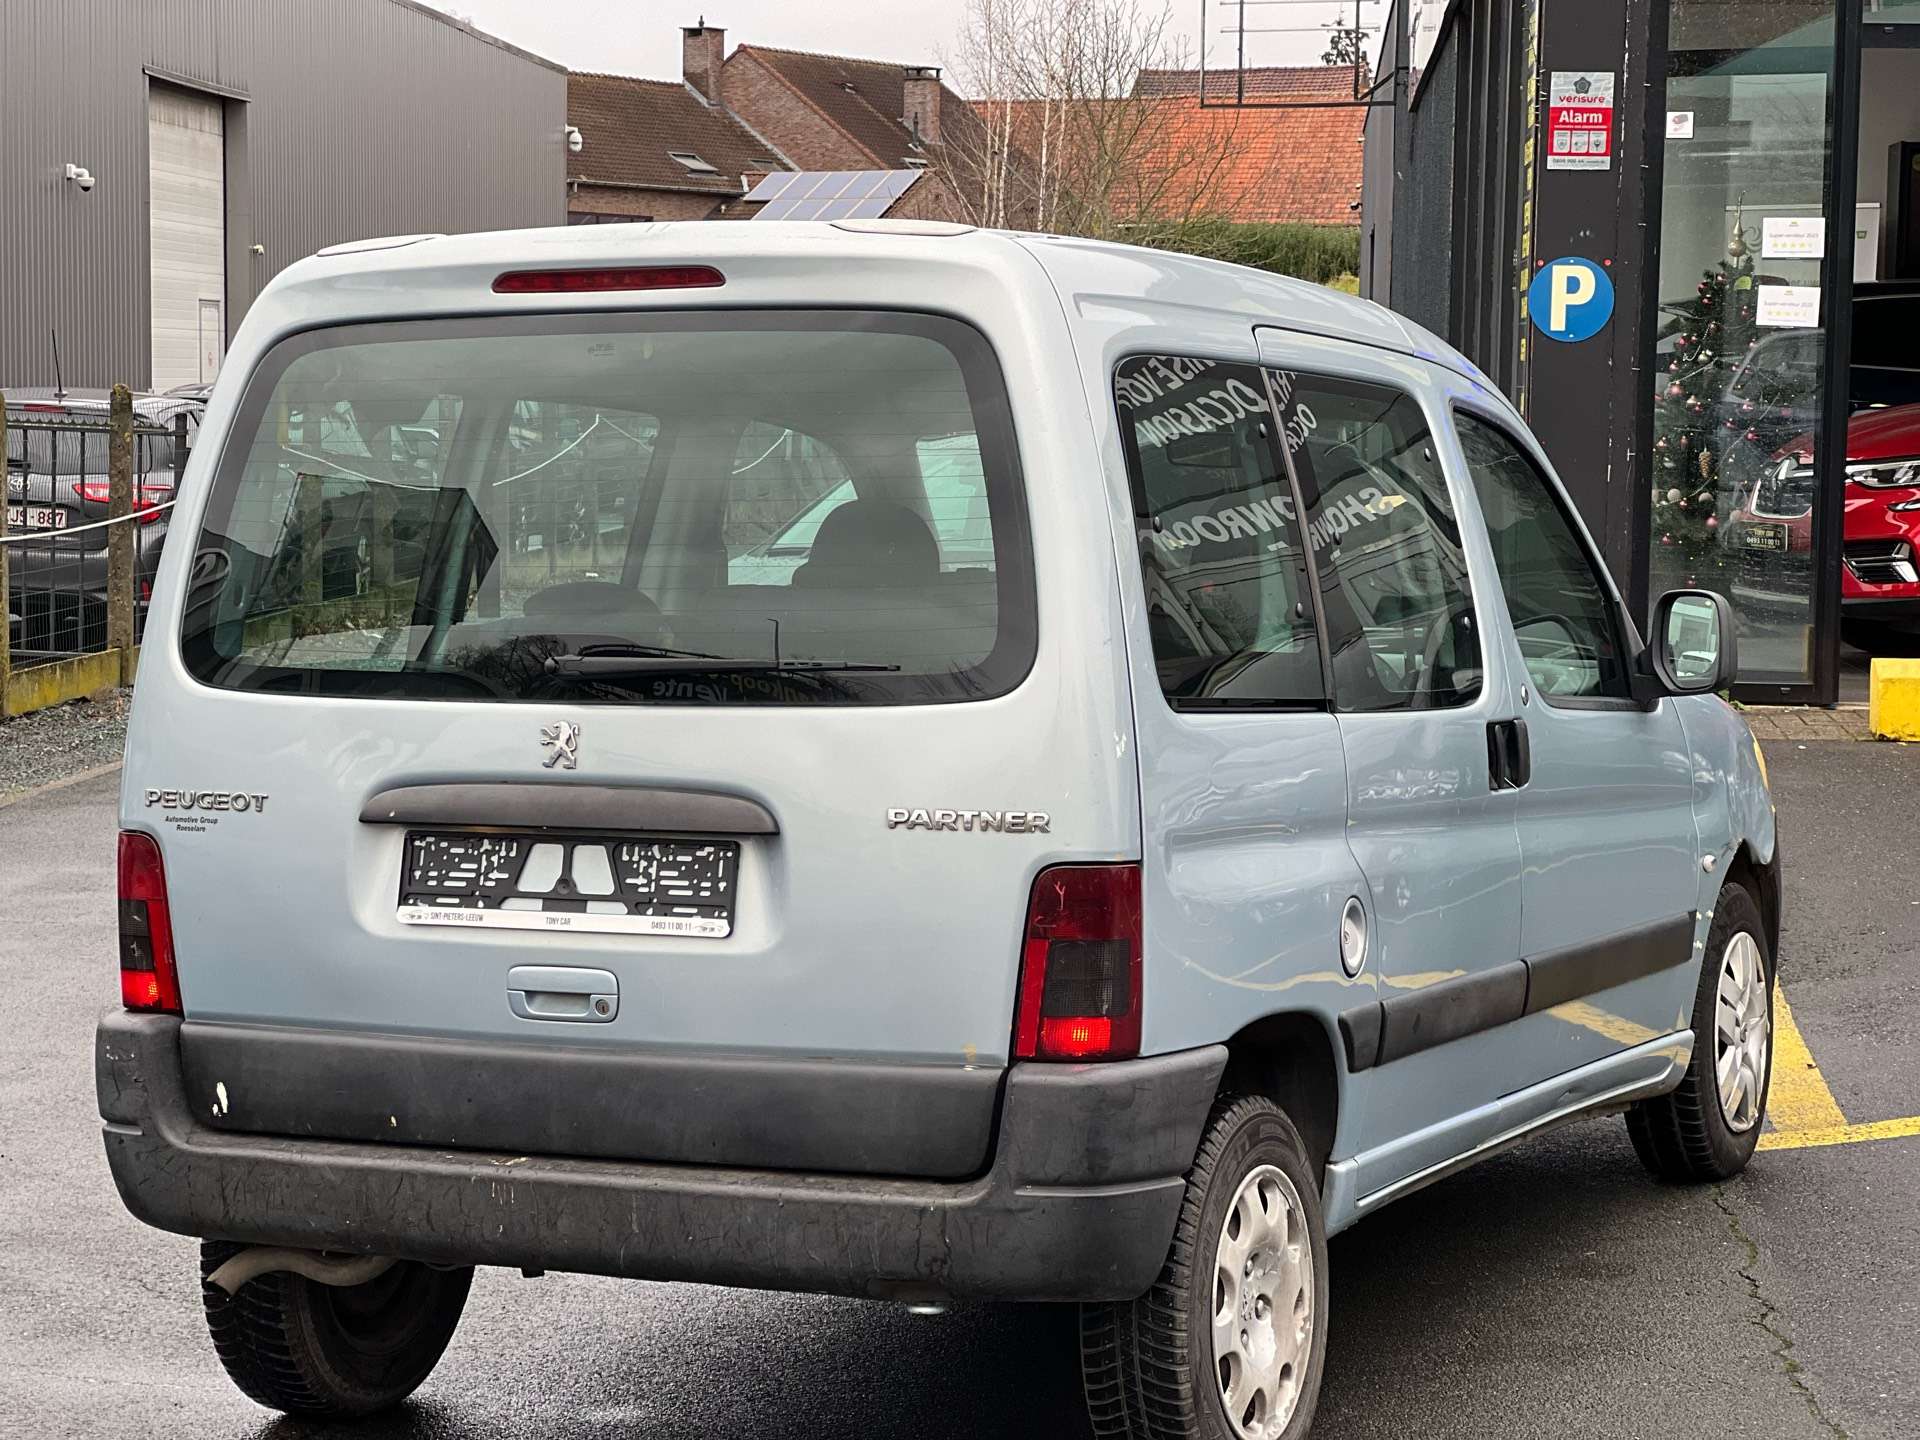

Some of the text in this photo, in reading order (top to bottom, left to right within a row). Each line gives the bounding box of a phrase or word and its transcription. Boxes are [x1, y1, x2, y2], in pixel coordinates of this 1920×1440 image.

[1559, 95, 1606, 104] verisure
[1559, 109, 1603, 123] Alarm
[1549, 264, 1596, 331] P
[144, 788, 269, 812] PEUGEOT
[165, 815, 218, 824] Automotive Group
[887, 808, 1051, 833] PARTNER
[176, 824, 206, 832] Roeselare
